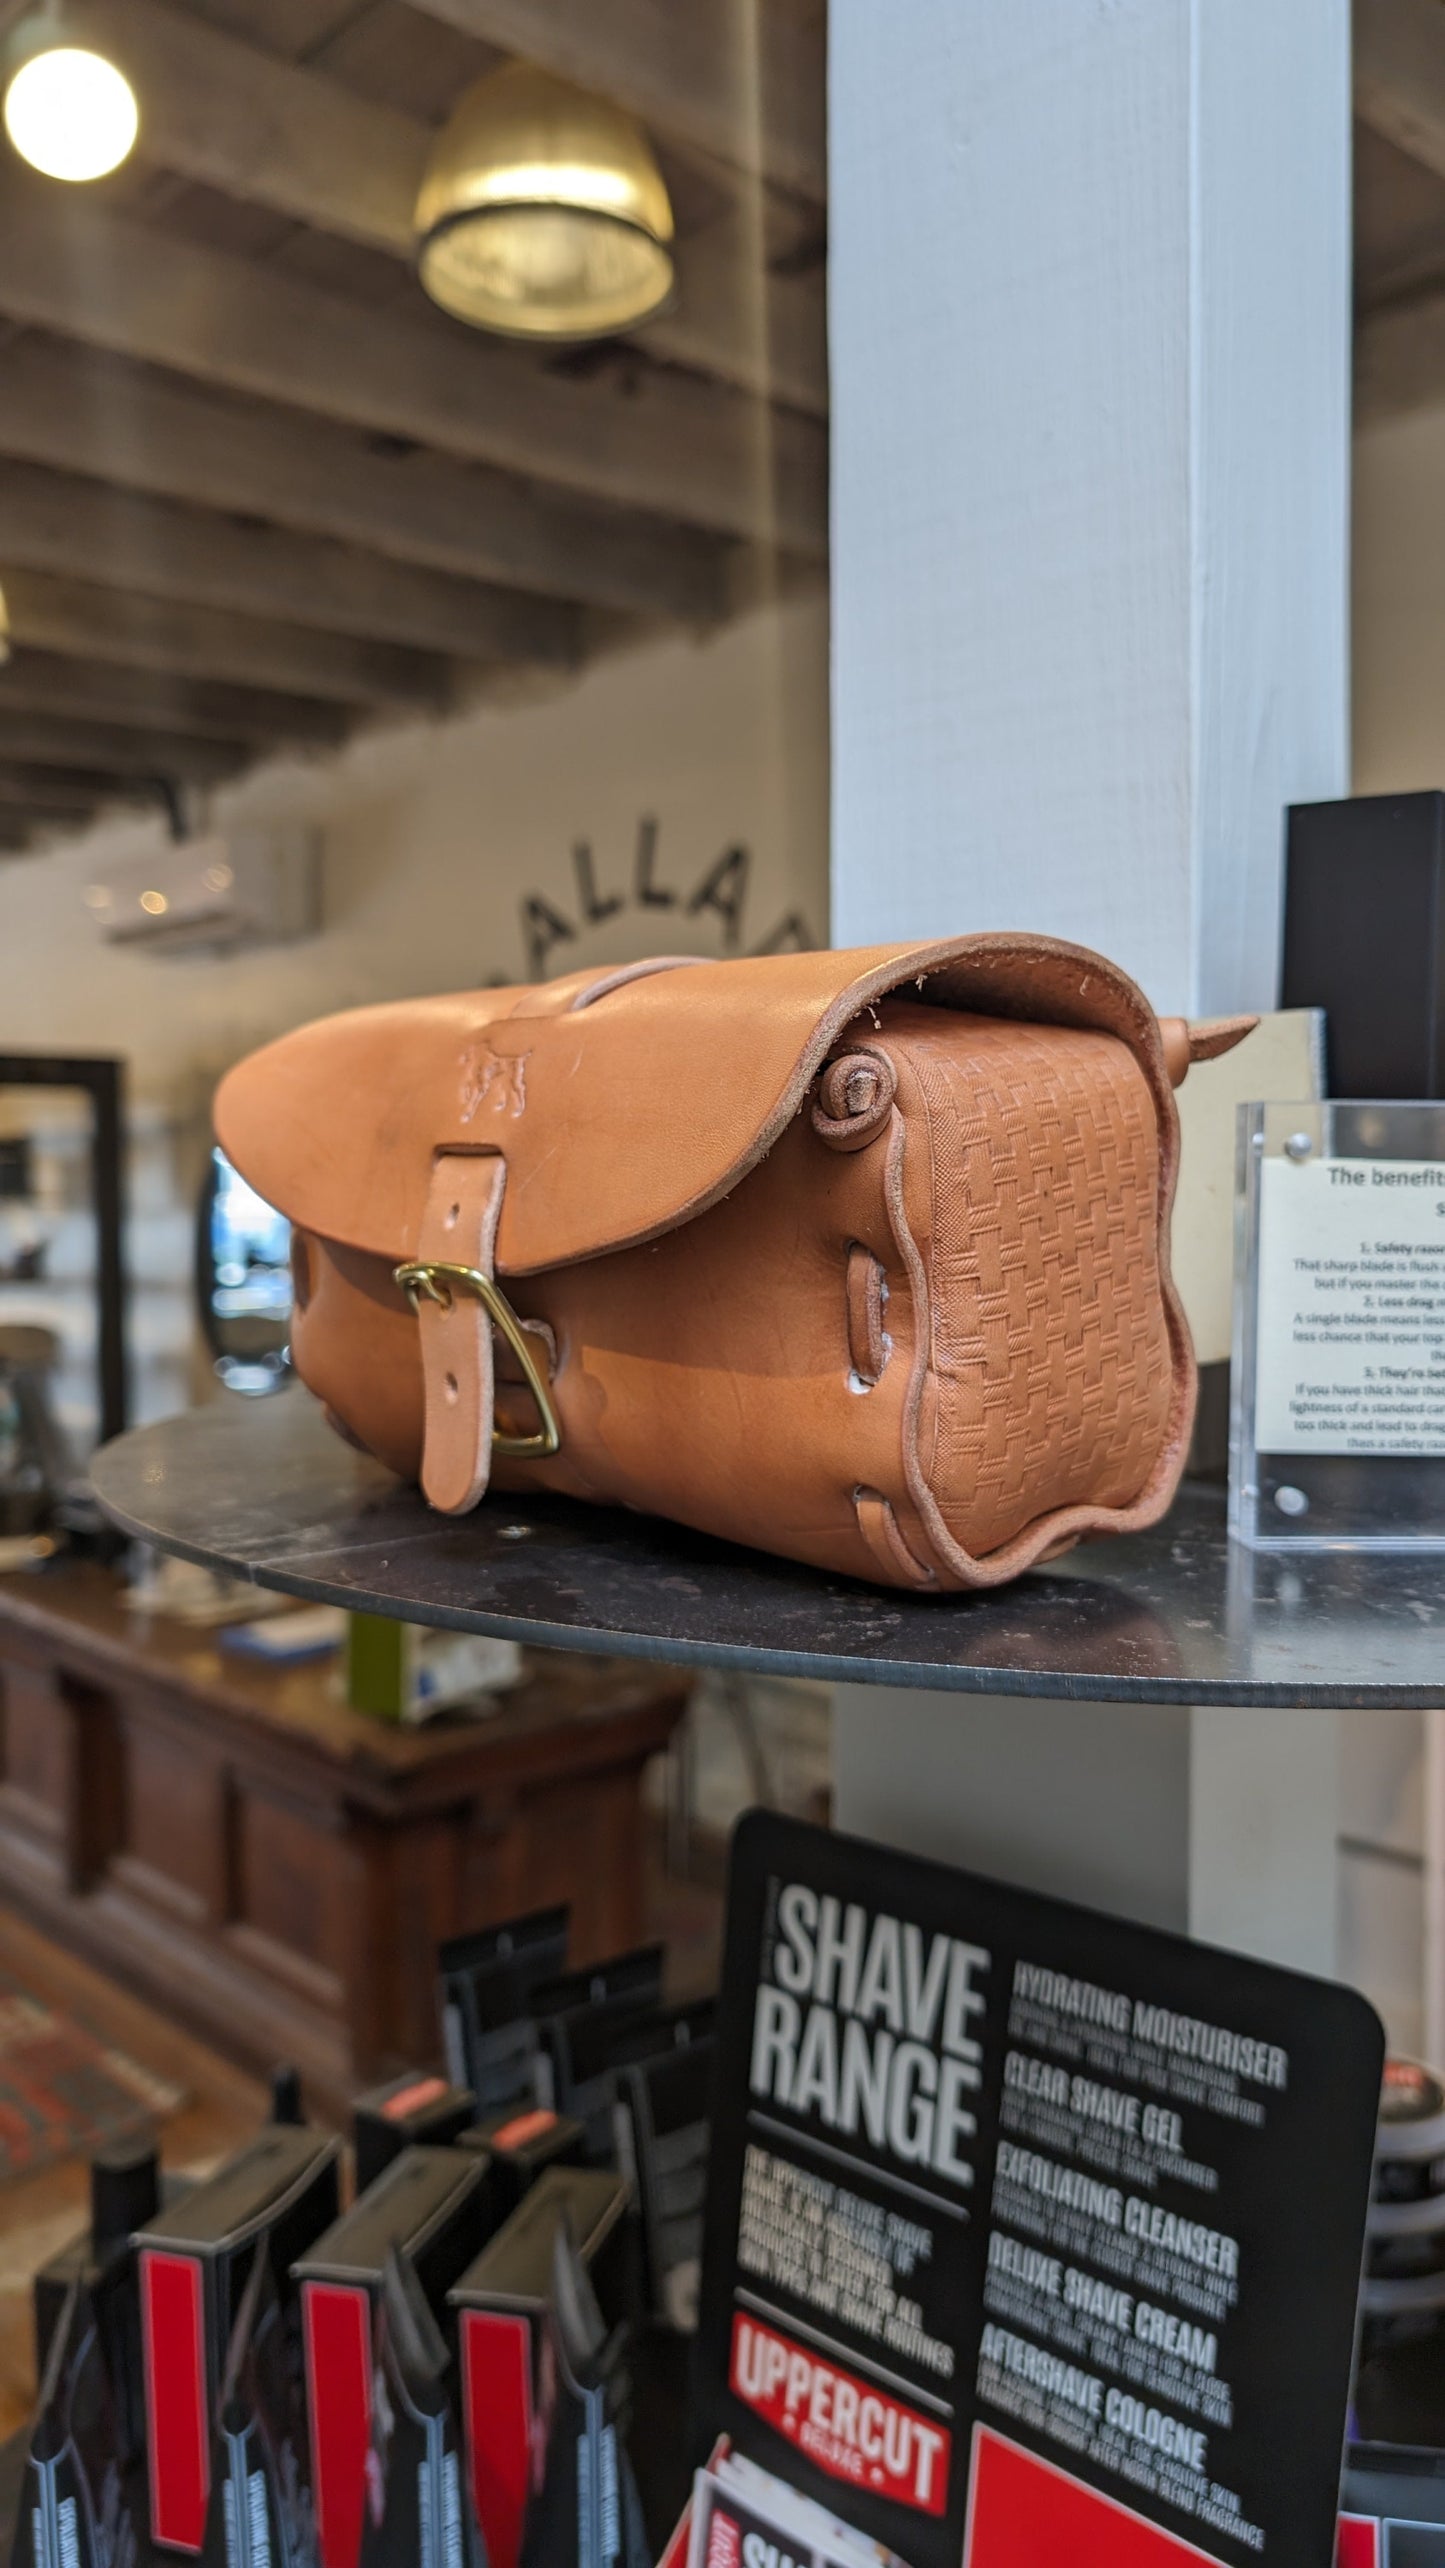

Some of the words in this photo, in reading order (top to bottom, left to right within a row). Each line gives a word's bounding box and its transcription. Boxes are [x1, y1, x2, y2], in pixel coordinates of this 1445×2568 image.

[1327, 1167, 1366, 1185] The
[1374, 1240, 1412, 1256] Safety
[1294, 1258, 1320, 1271] That
[1325, 1259, 1358, 1274] sharp
[1361, 1260, 1394, 1271] blade
[1410, 1260, 1438, 1272] flush
[1315, 1278, 1335, 1289] but
[1338, 1278, 1347, 1289] if
[1350, 1281, 1372, 1291] you
[1375, 1280, 1416, 1290] master
[1378, 1297, 1404, 1307] Less
[1406, 1297, 1434, 1309] drag
[1306, 1313, 1341, 1326] single
[1345, 1314, 1377, 1324] blade
[1381, 1316, 1420, 1325] means
[1293, 1331, 1316, 1341] less
[1320, 1331, 1361, 1342] chance
[1366, 1332, 1389, 1342] that
[1392, 1334, 1420, 1344] your
[1380, 1367, 1424, 1379] They're
[1307, 1386, 1329, 1396] you
[1333, 1384, 1361, 1395] have
[1364, 1386, 1392, 1395] thick
[1290, 1401, 1343, 1415] lightness
[1346, 1402, 1358, 1413] of
[1372, 1403, 1424, 1414] standard
[1295, 1420, 1315, 1430] too
[1318, 1420, 1347, 1431] thick
[773, 1883, 991, 2063] SHAVE
[1012, 1959, 1132, 2036] HYDRATING
[1131, 1999, 1289, 2091] MOISTURISER
[749, 1983, 982, 2189] RANGE
[1003, 2048, 1070, 2108] CLEAR
[1069, 2073, 1143, 2137] SHAVE
[1140, 2100, 1186, 2155] GEL
[994, 2138, 1125, 2230] EXFOLIATING
[1123, 2193, 1240, 2282] CLEANSER
[986, 2228, 1064, 2300] DELUXE
[1062, 2264, 1136, 2336] SHAVE
[1133, 2297, 1218, 2375] CREAM
[979, 2319, 1105, 2419] AFTERSHAVE
[1103, 2383, 1209, 2474] COLOGNE
[735, 2322, 944, 2505] UPPERCUT
[1195, 2492, 1267, 2555] FRAGRANCE
